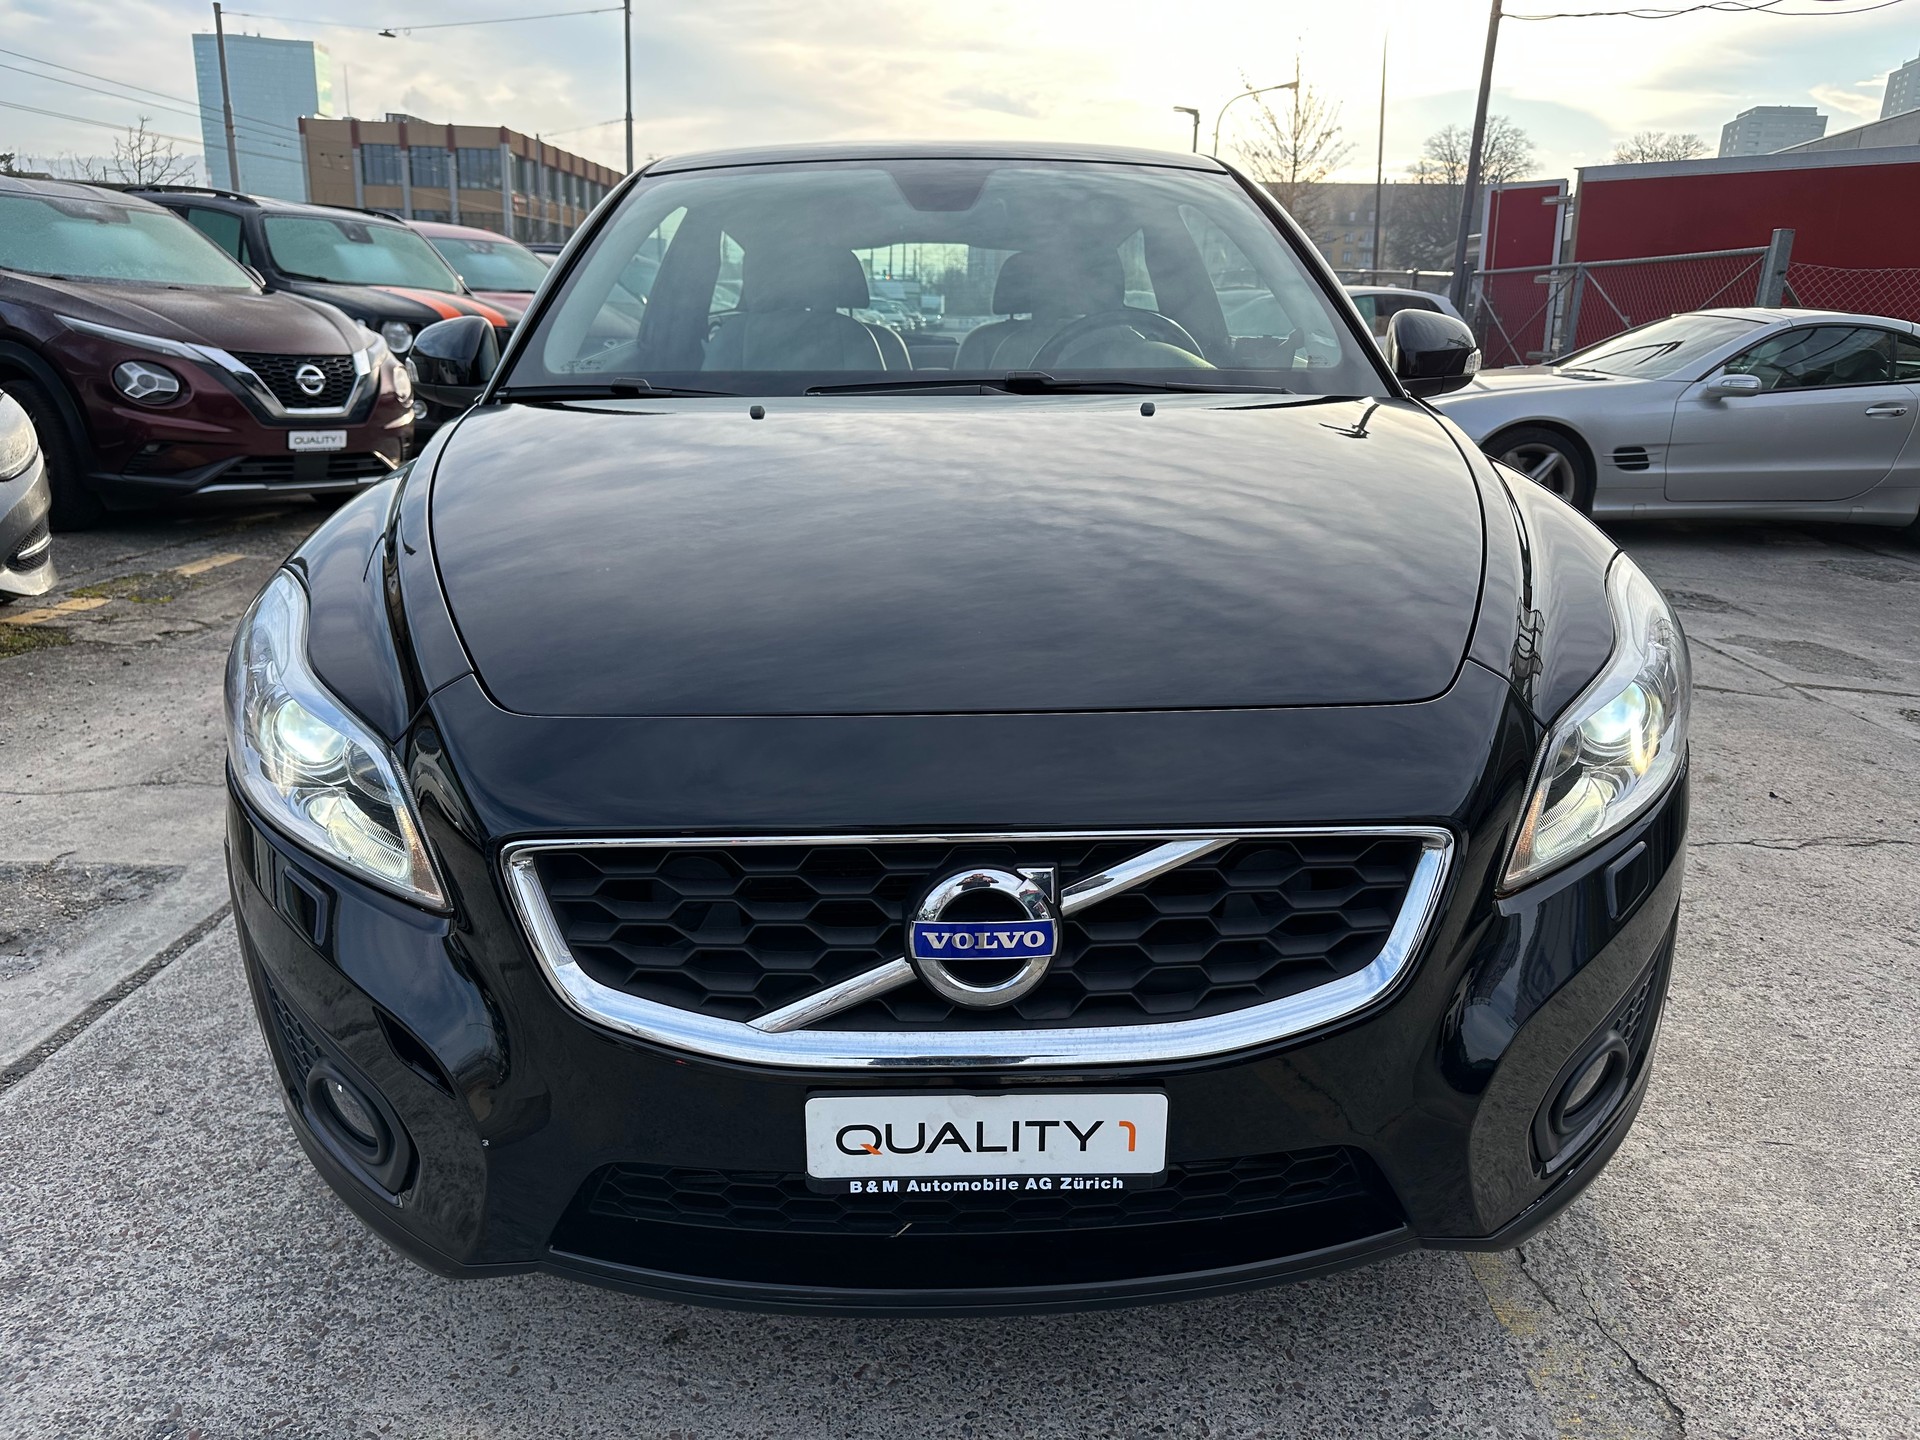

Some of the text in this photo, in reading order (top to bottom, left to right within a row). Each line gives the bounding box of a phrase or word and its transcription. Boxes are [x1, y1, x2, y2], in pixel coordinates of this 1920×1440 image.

[294, 436, 337, 445] QUALITY
[922, 931, 1046, 950] VOLVO
[835, 1120, 1137, 1156] QUALITY 1
[906, 1178, 1019, 1193] Automobile
[1025, 1177, 1053, 1190] AG
[1059, 1177, 1124, 1190] Zürich
